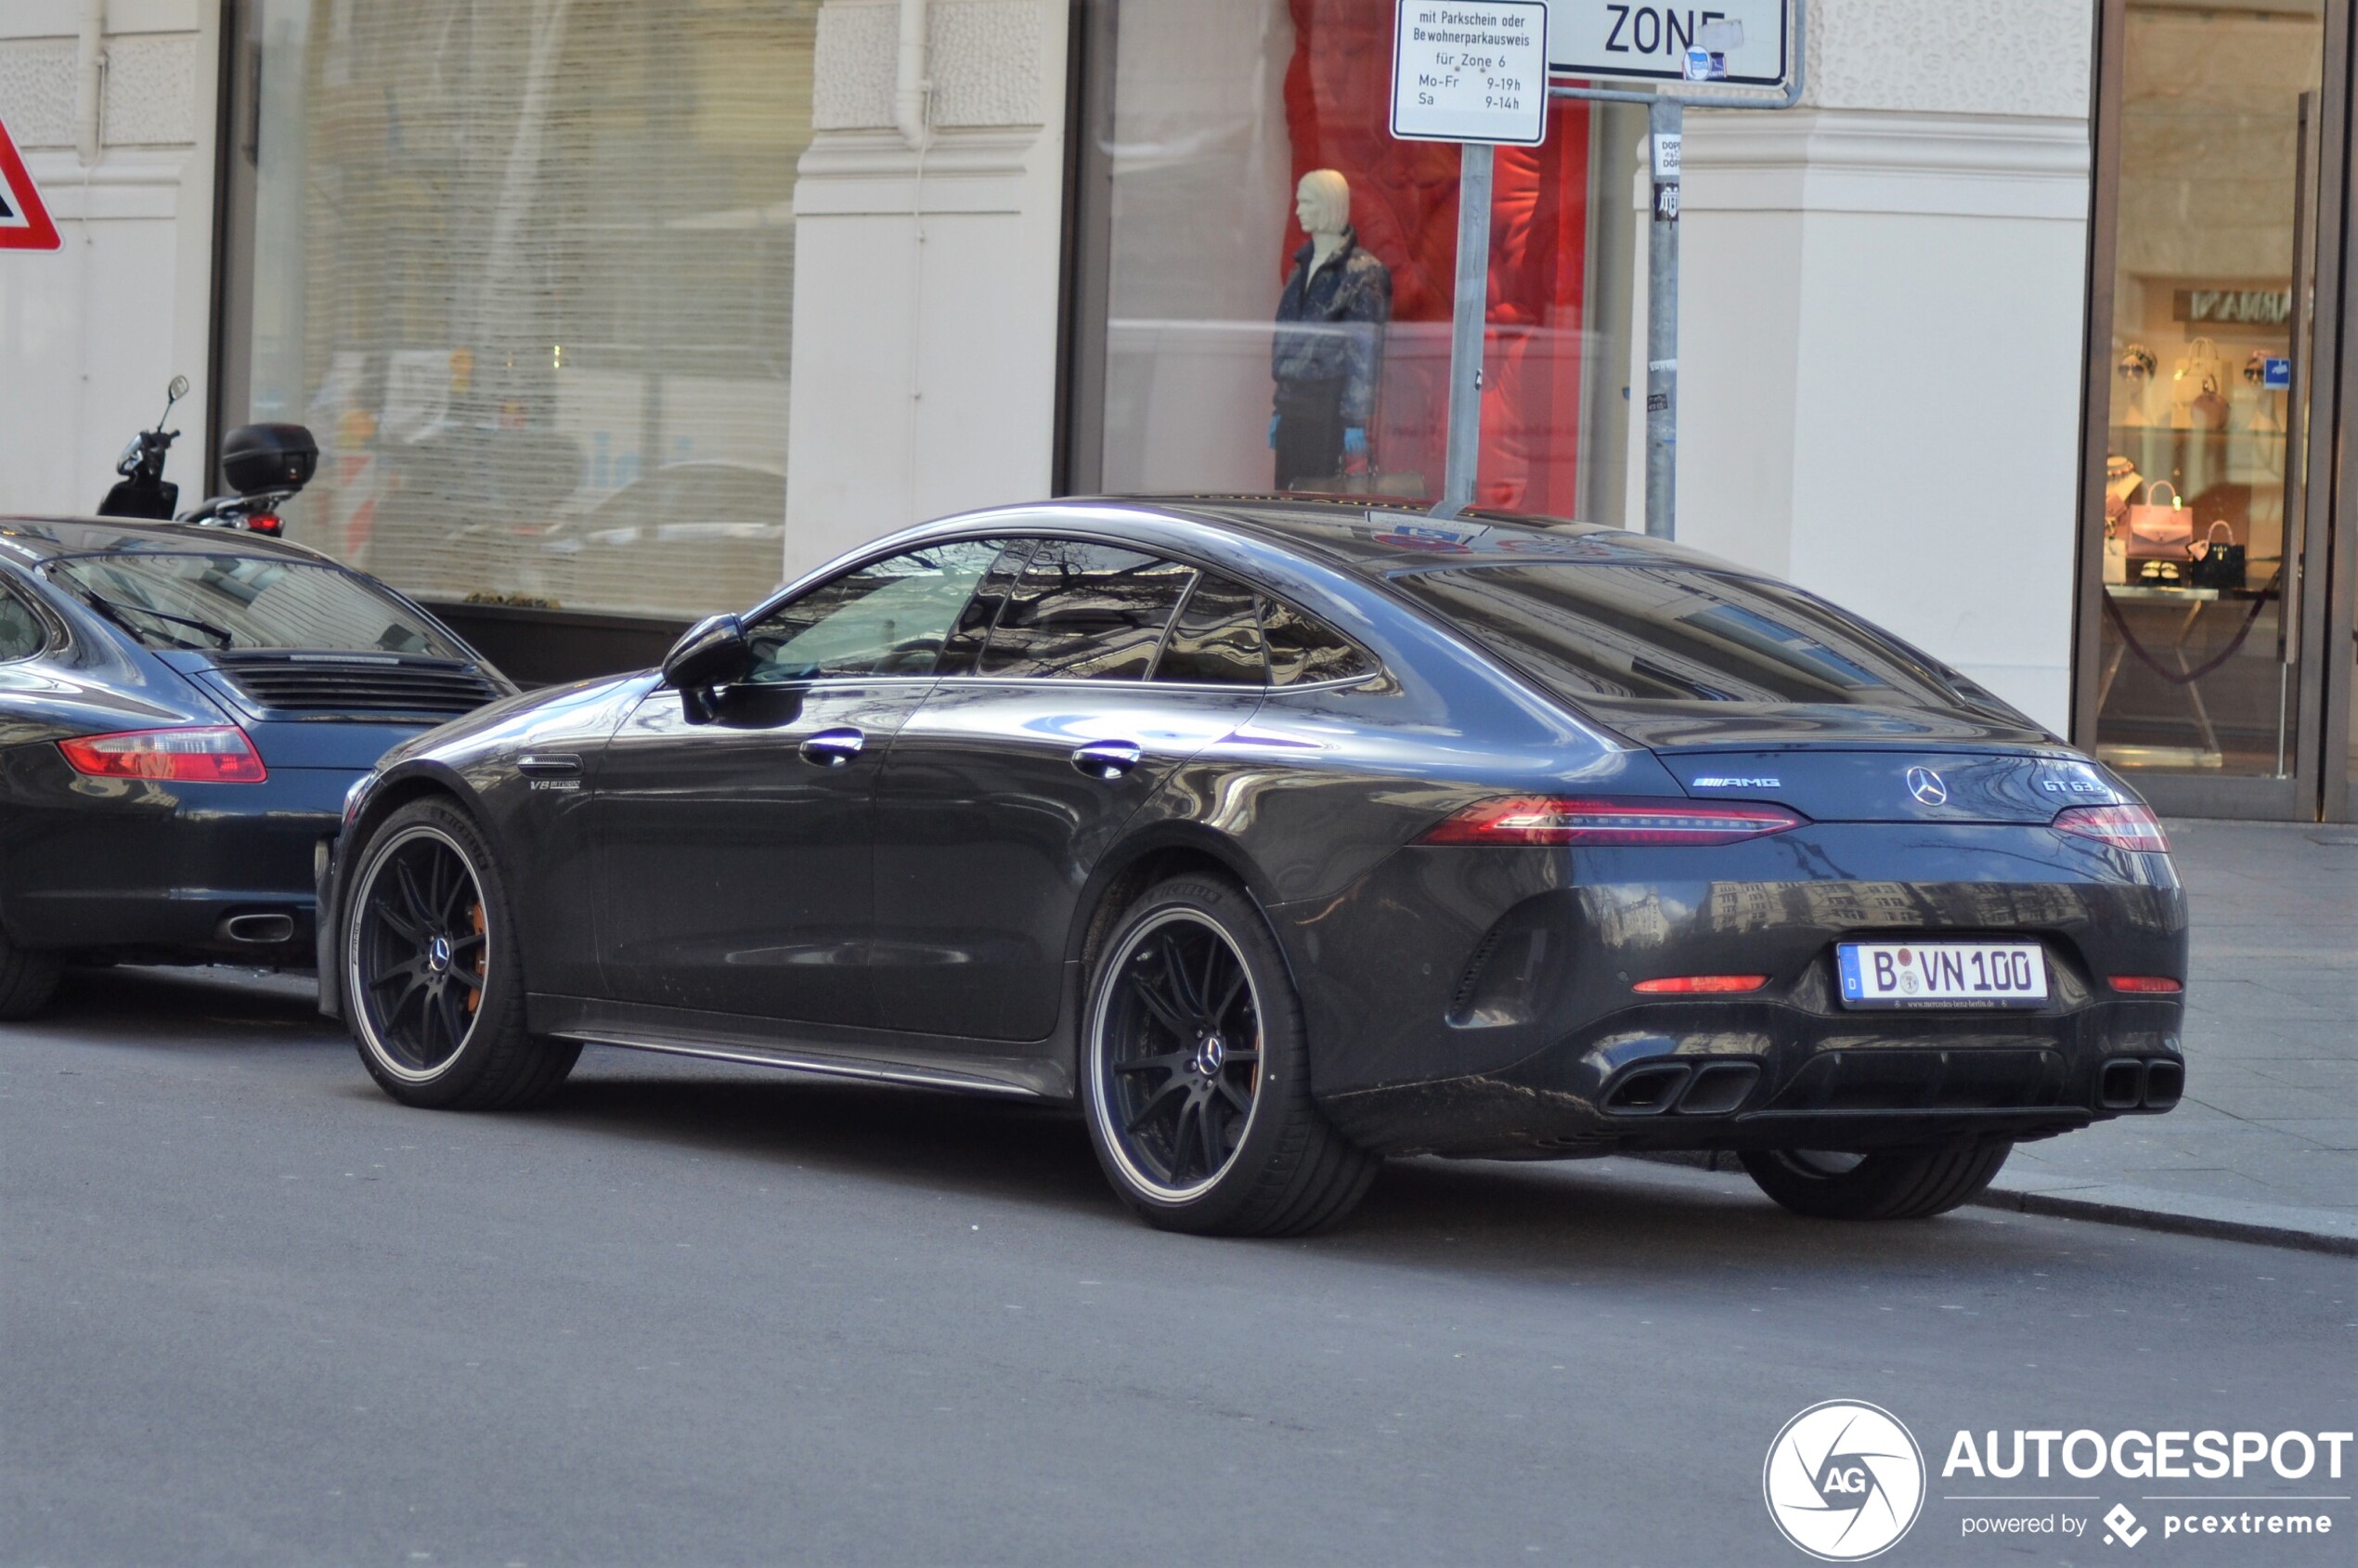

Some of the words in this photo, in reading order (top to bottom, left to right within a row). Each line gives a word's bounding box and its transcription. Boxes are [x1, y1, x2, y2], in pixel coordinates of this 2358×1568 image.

[1419, 10, 1436, 23] mit
[1442, 10, 1496, 26] Parkschein
[1502, 14, 1525, 28] oder
[1436, 53, 1454, 65] für
[1461, 54, 1492, 67] Zone
[1498, 56, 1506, 68] 6
[1419, 74, 1459, 88] Mo-Fr
[1419, 93, 1434, 105] Sa
[1664, 159, 1680, 167] DOP
[1721, 778, 1781, 787] AMG
[2042, 781, 2066, 792] GT
[2069, 782, 2094, 792] 63
[1873, 952, 1898, 991] B
[1848, 978, 1857, 990] D
[1908, 1000, 1994, 1008] www.mercedes-benz-berlin.de
